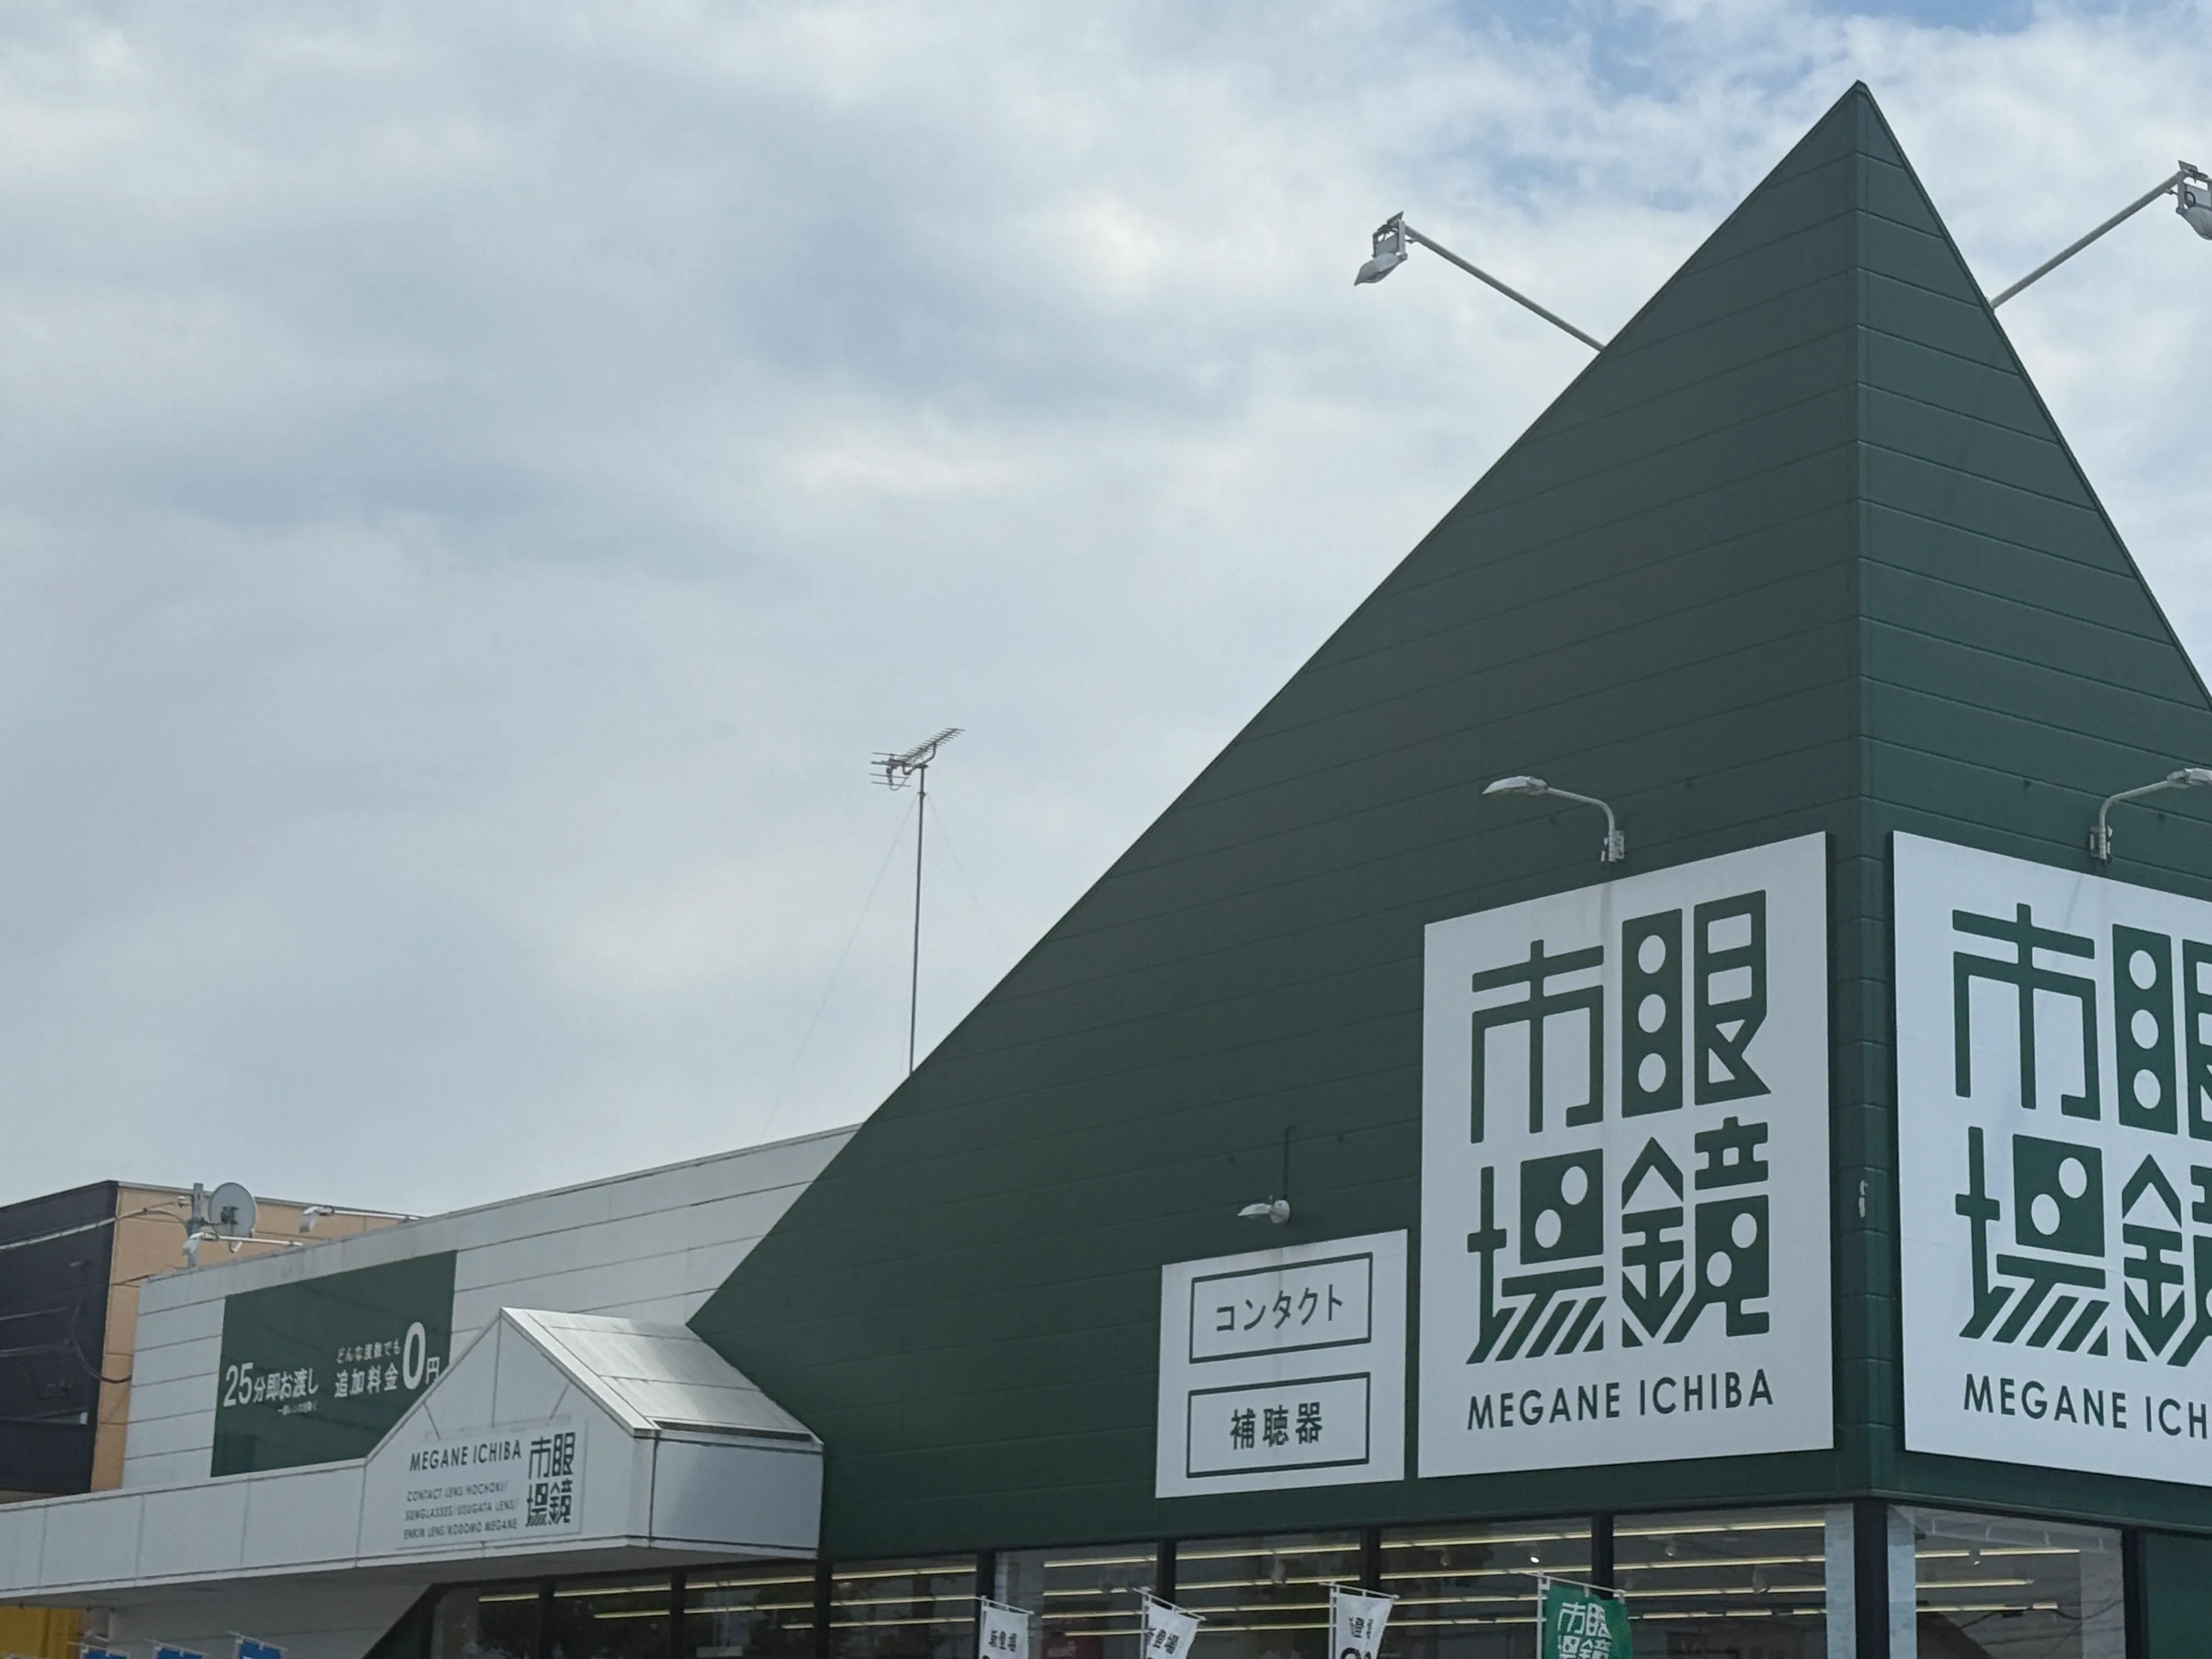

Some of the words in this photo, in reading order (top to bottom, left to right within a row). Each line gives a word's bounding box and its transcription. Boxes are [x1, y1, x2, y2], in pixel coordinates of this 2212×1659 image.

[1216, 1284, 1342, 1331] コンタクト
[1466, 1381, 1620, 1430] MEGANE
[1639, 1368, 1773, 1415] ICHIBA
[1963, 1373, 2127, 1429] MEGANE
[2146, 1396, 2208, 1440] ICH
[1230, 1402, 1323, 1449] 補聴器
[409, 1446, 467, 1471] MEGANE
[472, 1440, 522, 1464] ICHIBA
